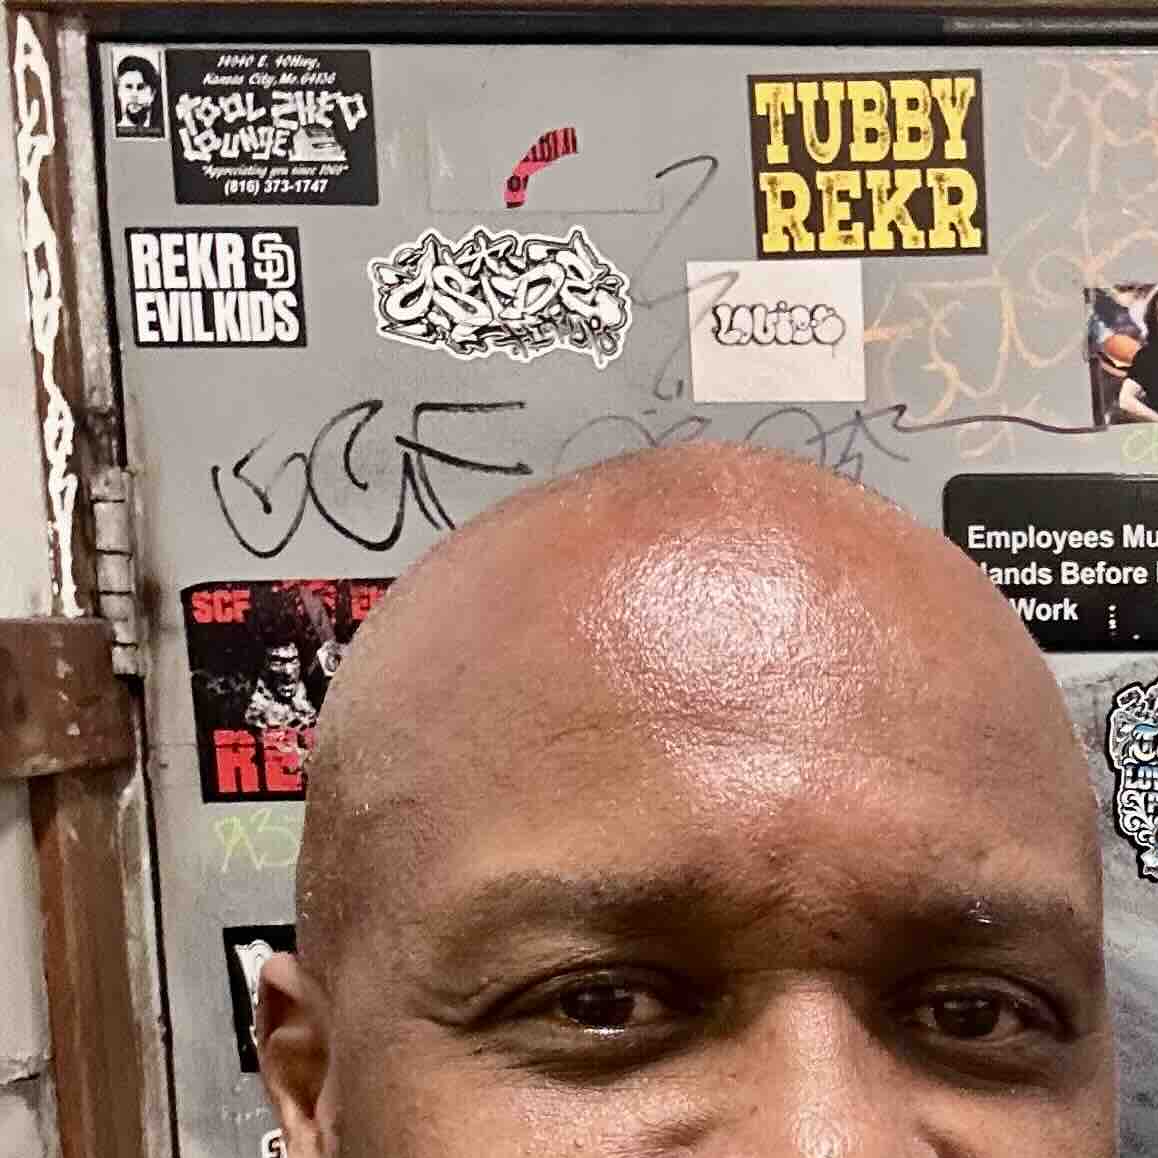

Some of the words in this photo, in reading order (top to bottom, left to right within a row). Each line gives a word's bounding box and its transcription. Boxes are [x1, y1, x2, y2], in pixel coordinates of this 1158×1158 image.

[175, 91, 267, 135] TOOL
[270, 90, 368, 132] SHED
[755, 77, 977, 164] TUBBY
[224, 179, 260, 196] (816)
[263, 179, 329, 193] 373-1747
[759, 168, 982, 253] REKR
[129, 232, 248, 291] REKR
[967, 524, 1114, 555] Employees
[1060, 560, 1149, 586] Before
[191, 590, 251, 623] SCF
[1011, 597, 1079, 622] Work
